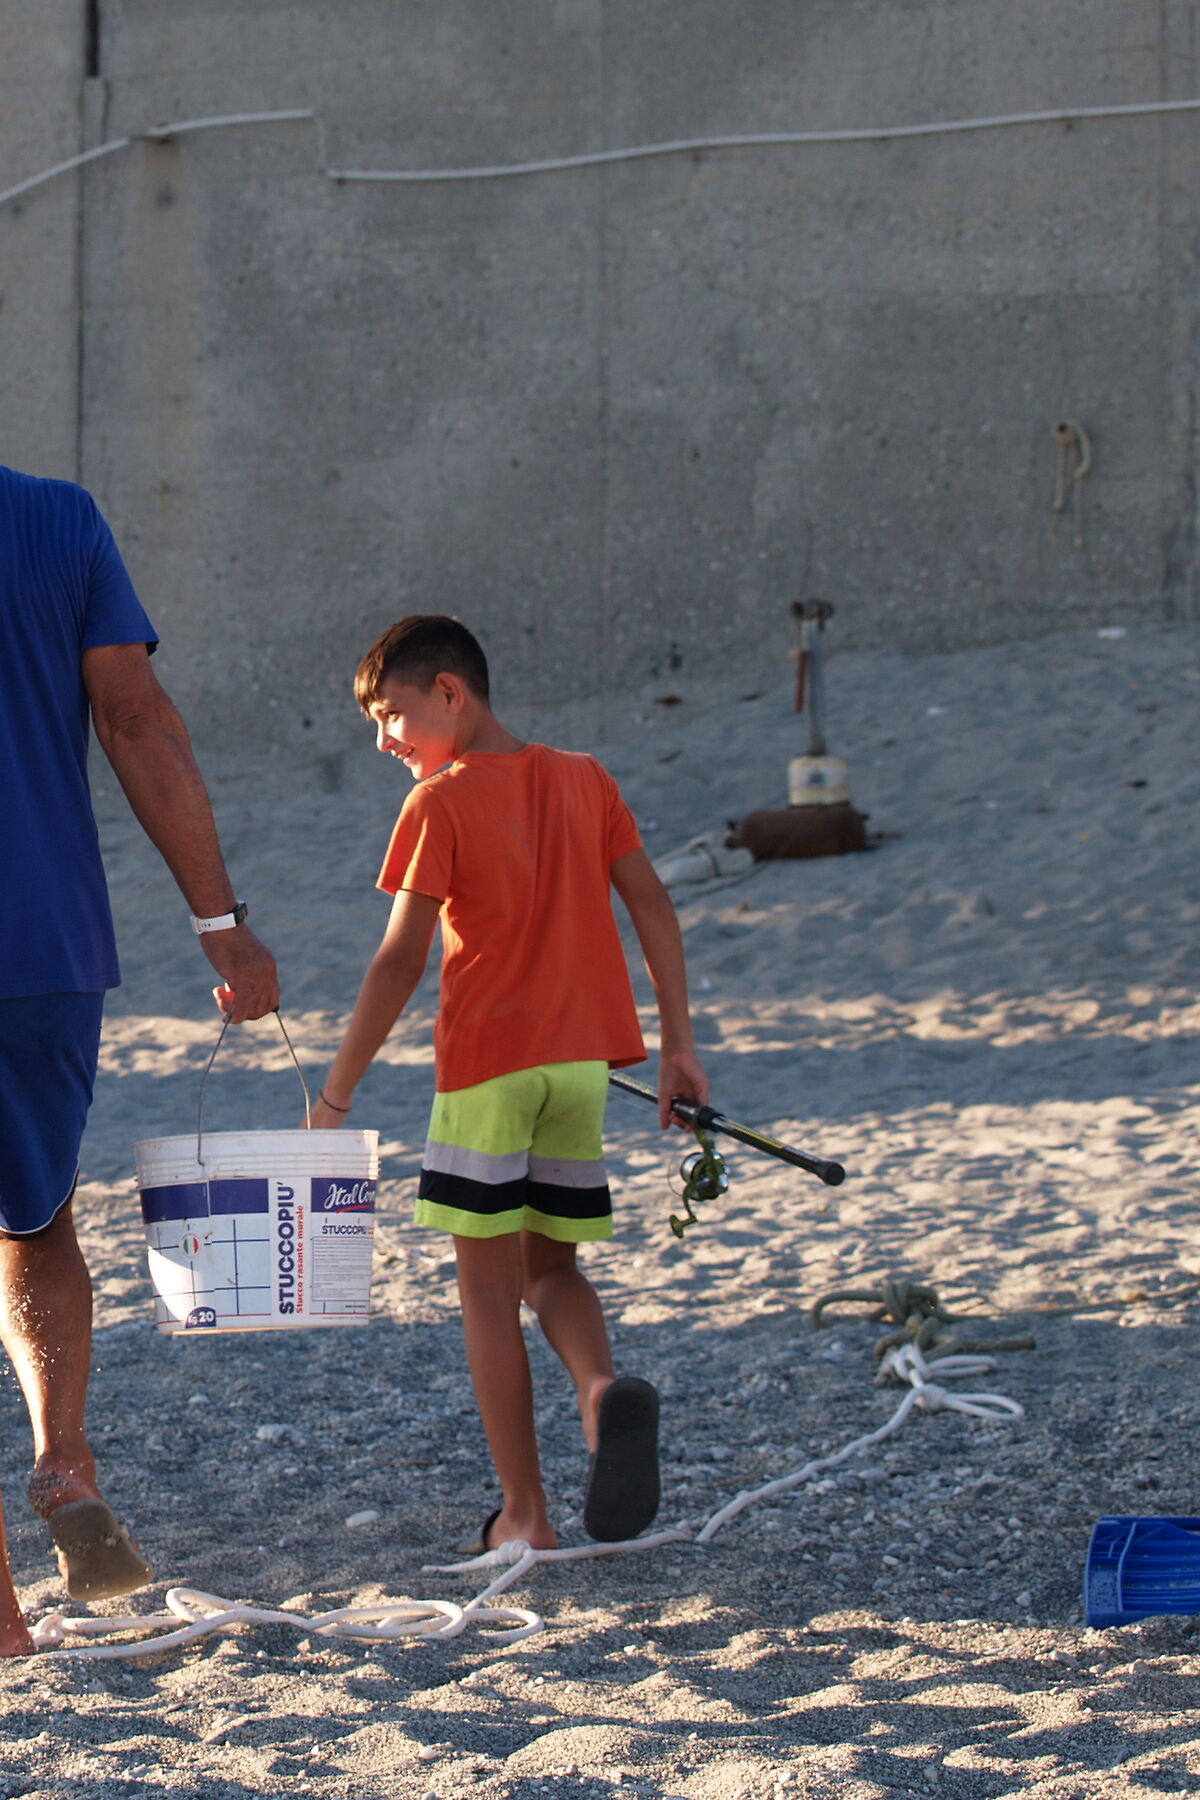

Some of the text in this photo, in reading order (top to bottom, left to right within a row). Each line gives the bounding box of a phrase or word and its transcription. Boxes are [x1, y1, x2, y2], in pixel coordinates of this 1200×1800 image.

[296, 1205, 304, 1314] Stucco rasante murale
[198, 1311, 214, 1322] 20
